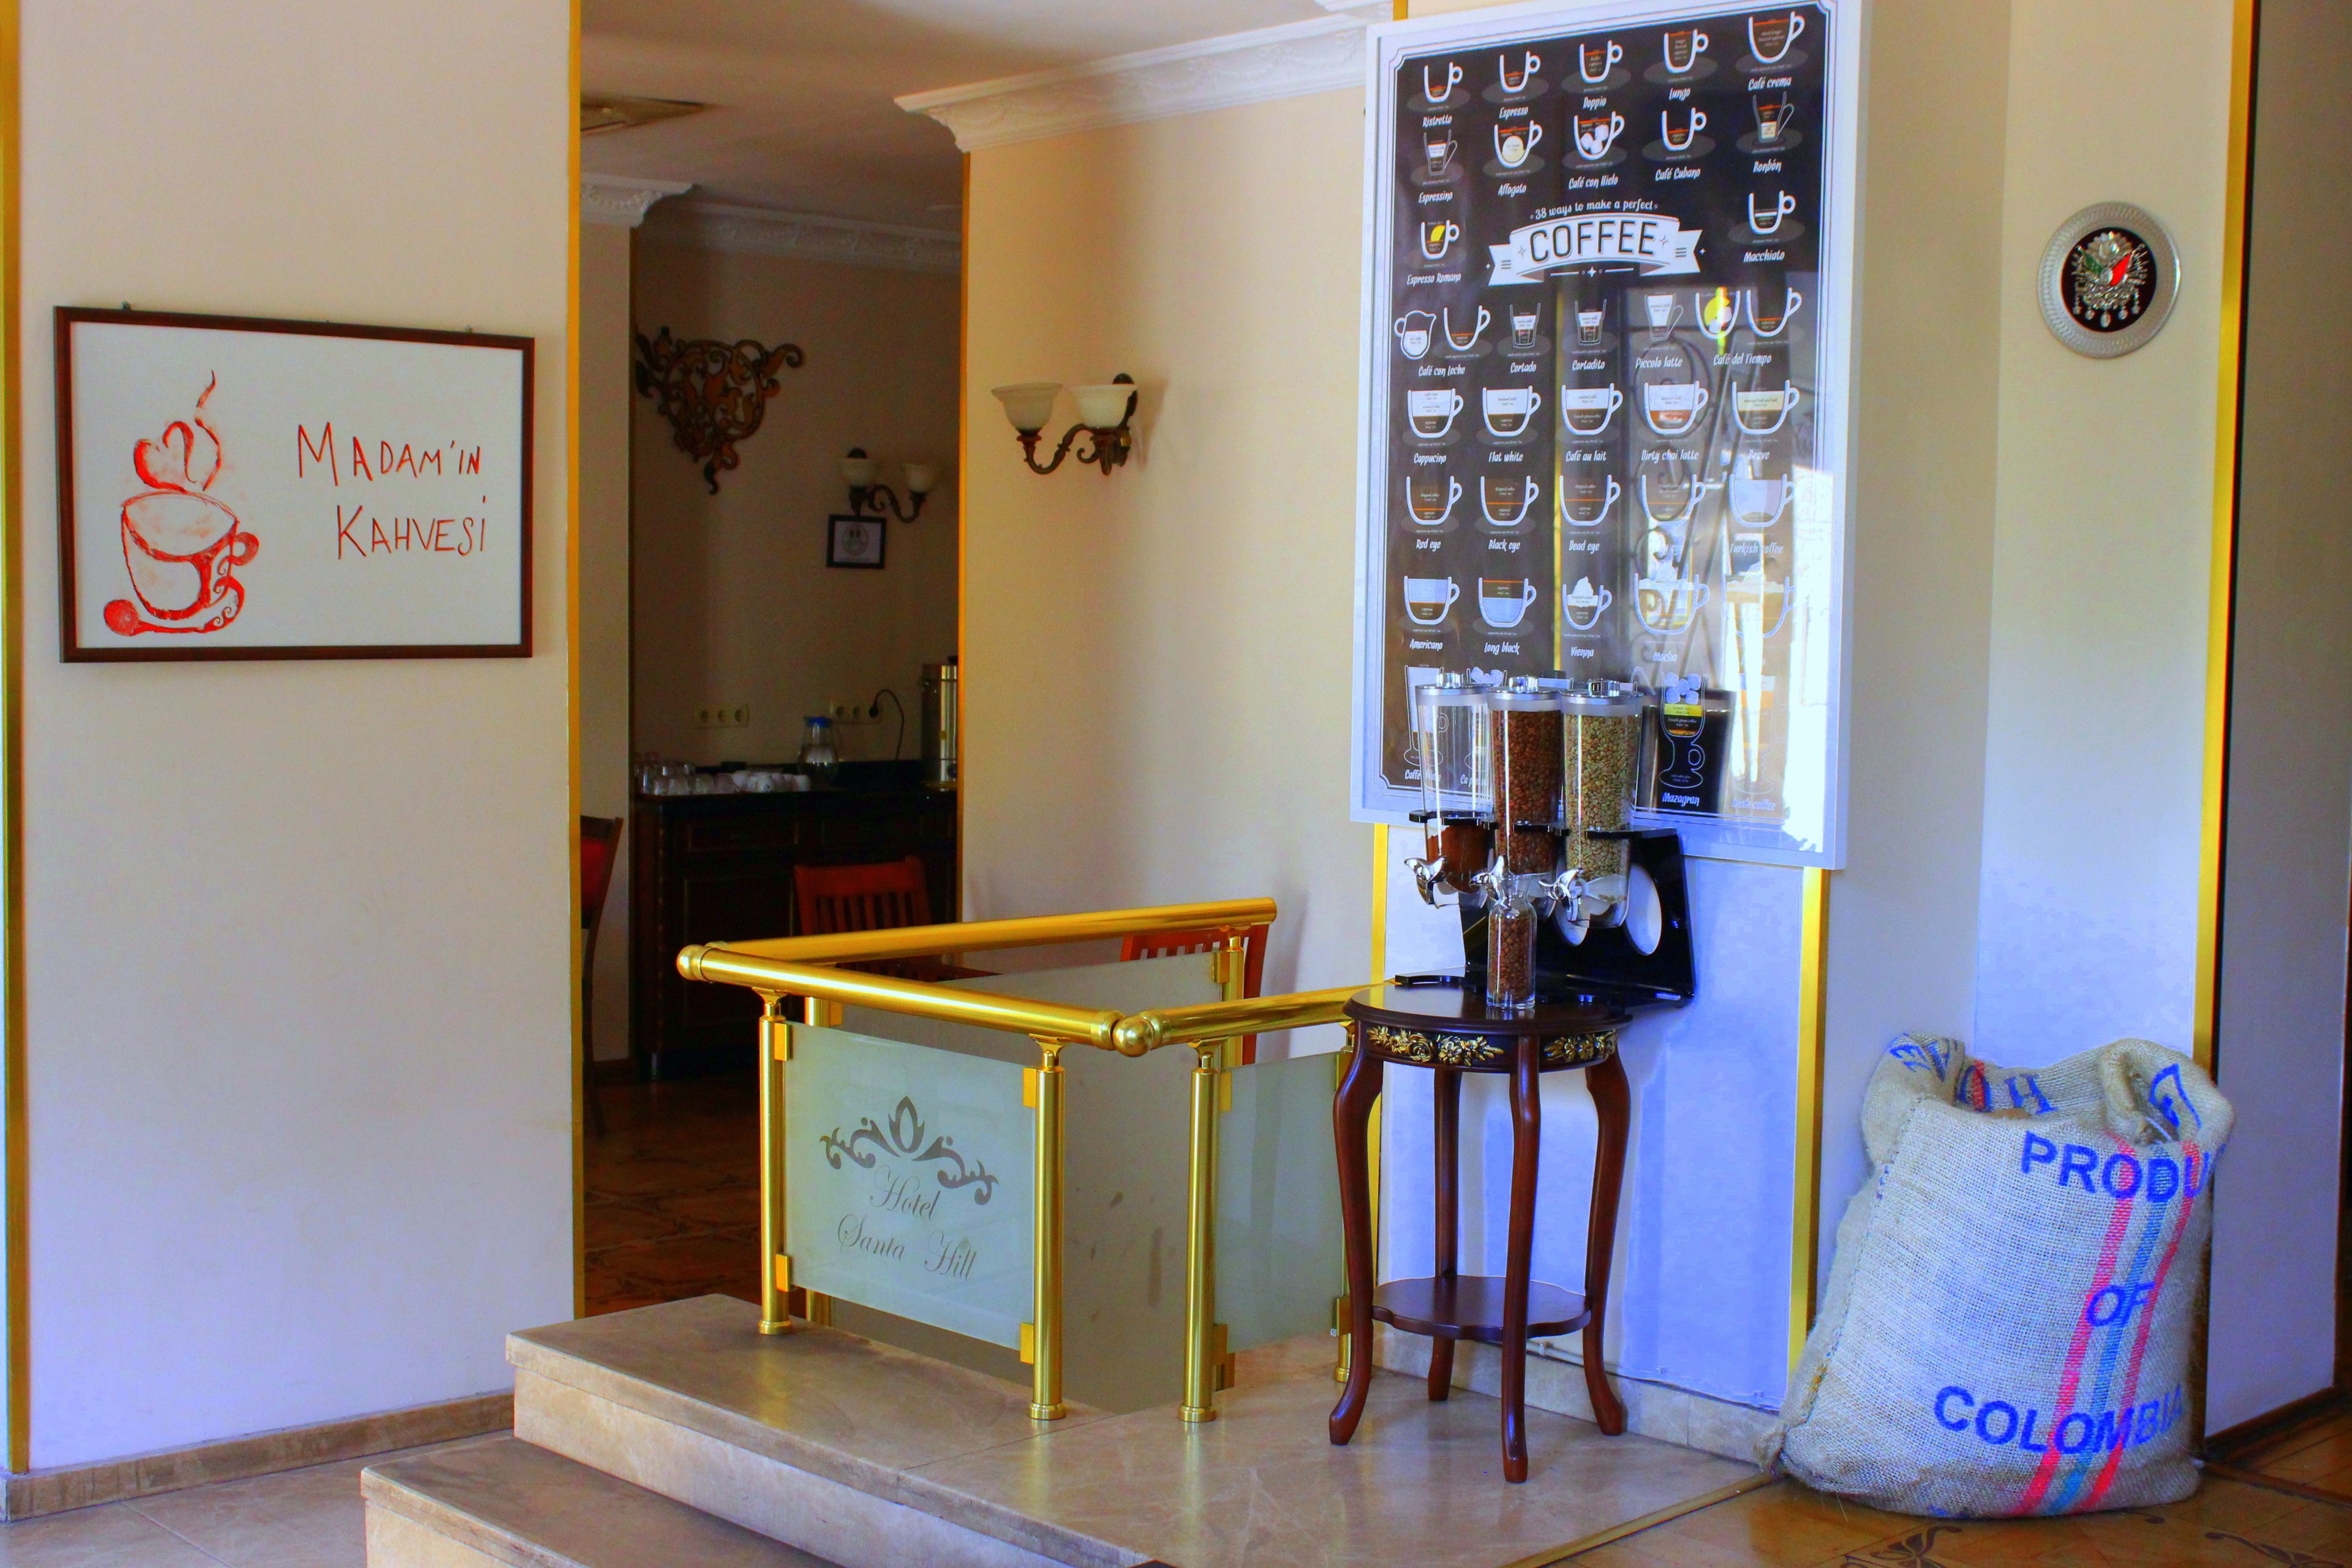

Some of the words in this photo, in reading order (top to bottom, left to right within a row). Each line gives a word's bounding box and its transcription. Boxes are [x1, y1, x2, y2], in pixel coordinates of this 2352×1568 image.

[1748, 76, 1766, 91] Café
[1767, 77, 1792, 89] crema
[1669, 88, 1691, 101] Lungo
[1583, 96, 1607, 110] Doppio
[1499, 106, 1528, 119] Espresso
[1422, 114, 1452, 127] Ristretto
[1656, 168, 1672, 181] Café
[1674, 166, 1701, 179] Cubano
[1569, 176, 1585, 189] Café
[1585, 178, 1599, 189] con
[1418, 190, 1453, 206] Espressino
[1498, 184, 1526, 198] Affogato
[1535, 208, 1547, 220] 38
[1549, 204, 1572, 217] ways
[1575, 202, 1584, 212] to
[1586, 199, 1612, 211] make
[1614, 201, 1620, 209] a
[1623, 198, 1653, 212] perfect
[1529, 219, 1659, 263] COFFEE
[1744, 249, 1785, 263] Macchiato
[1407, 273, 1435, 286] Espresso
[1436, 271, 1461, 284] Romano
[1572, 359, 1605, 372] Cortadito
[1635, 356, 1662, 369] Piccolo
[1664, 353, 1683, 367] latte
[1713, 352, 1730, 366] Café
[1732, 353, 1744, 365] del
[1744, 353, 1772, 365] Tiempo
[1419, 364, 1433, 377] Café
[1434, 368, 1446, 379] con
[1447, 364, 1466, 376] Leche
[1510, 360, 1537, 374] Cortado
[298, 421, 481, 487] MADAM'IN
[1414, 453, 1447, 465] Cappucino
[1488, 453, 1502, 463] Flat
[1504, 451, 1523, 462] white
[1566, 450, 1581, 462] Café
[1582, 453, 1593, 462] au
[1594, 450, 1607, 462] lait
[1641, 449, 1659, 464] Dirty
[1662, 450, 1679, 461] chai
[1680, 449, 1699, 461] latte
[1416, 538, 1430, 549] Red
[1431, 540, 1441, 552] eye
[1488, 539, 1507, 552] Black
[1509, 541, 1520, 553] eye
[1569, 540, 1585, 551] Dead
[1586, 542, 1600, 554] eye
[1730, 542, 1758, 556] Turkish
[1409, 638, 1443, 651] Americano
[1484, 642, 1500, 655] Long
[1501, 642, 1520, 655] black
[1570, 646, 1594, 658] Vienna
[1662, 792, 1700, 807] Mazagran
[2021, 1131, 2226, 1202] PRODU
[870, 1165, 941, 1221] Hotel
[838, 1214, 905, 1261] Santa
[924, 1229, 976, 1281] Hill
[2086, 1281, 2155, 1327] OF
